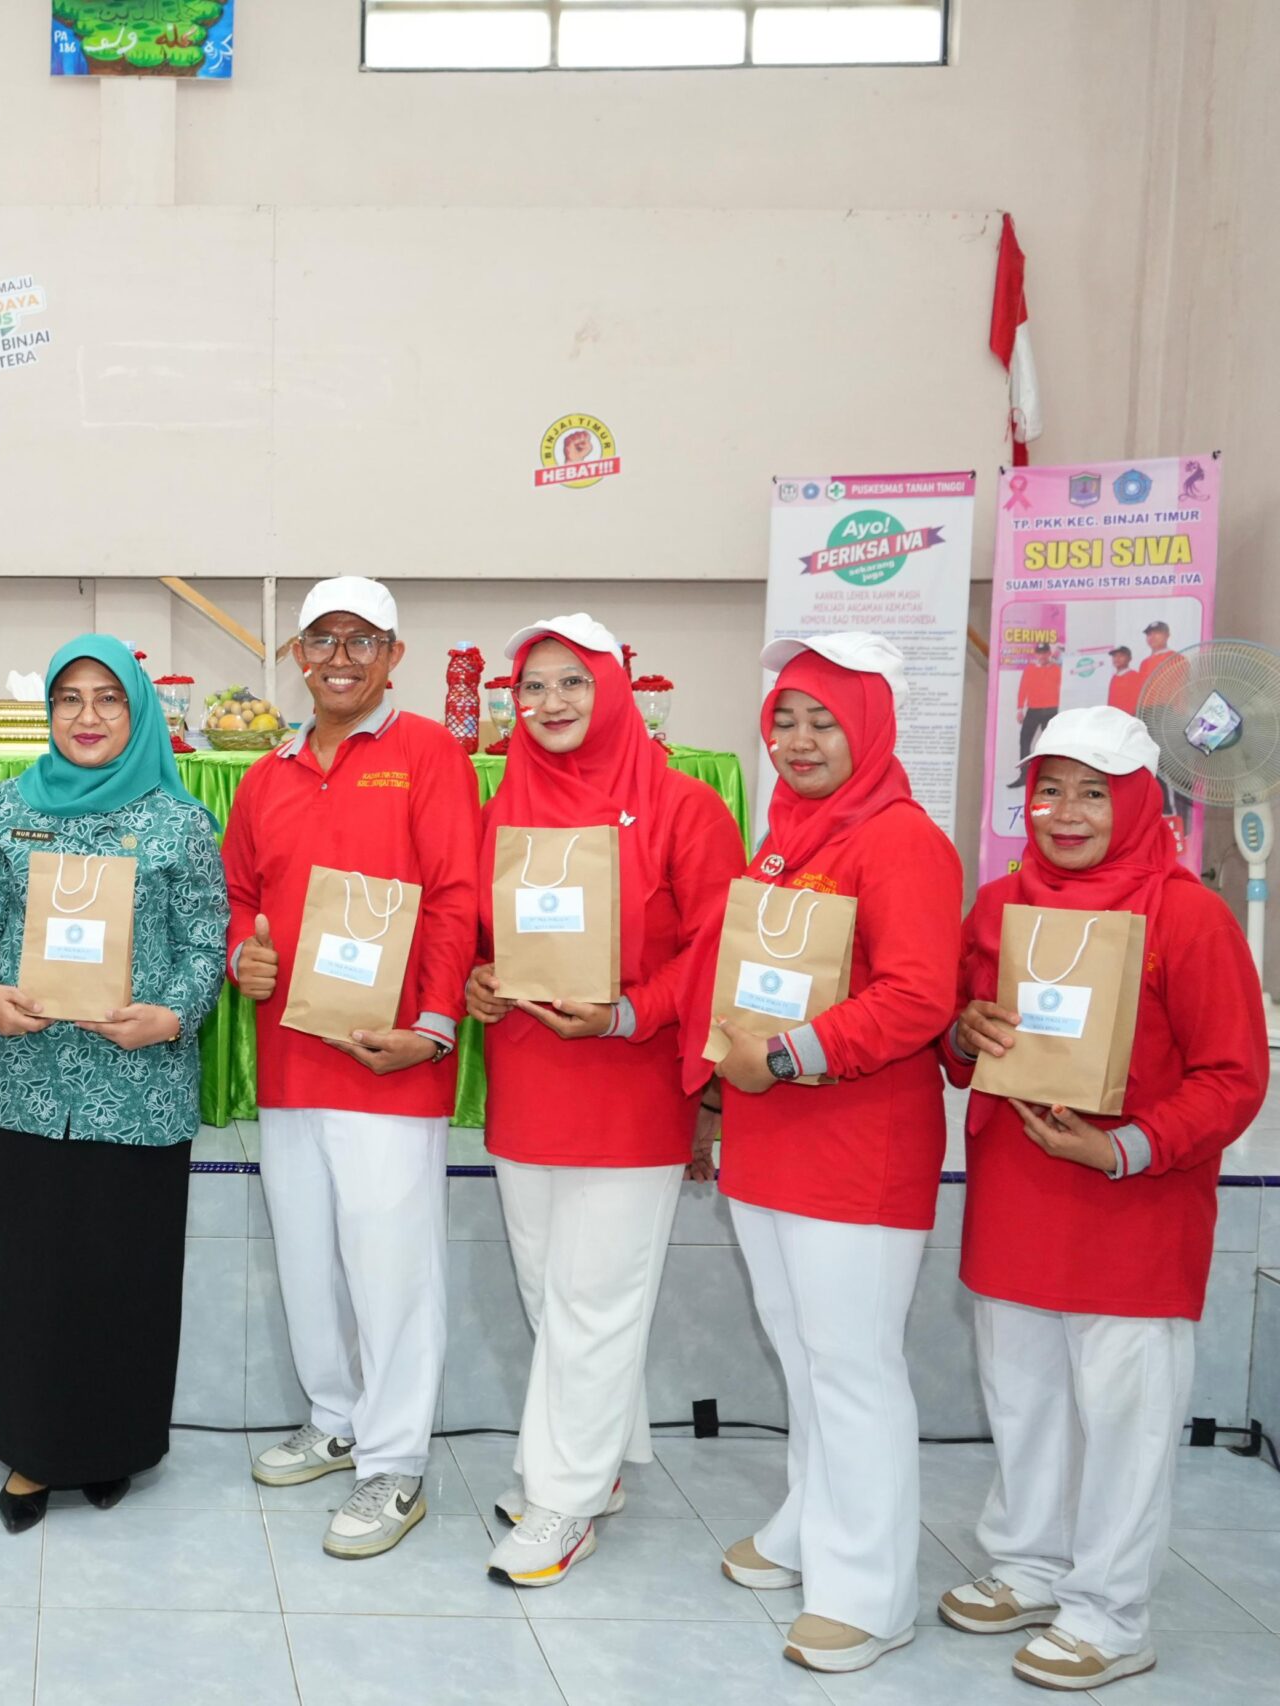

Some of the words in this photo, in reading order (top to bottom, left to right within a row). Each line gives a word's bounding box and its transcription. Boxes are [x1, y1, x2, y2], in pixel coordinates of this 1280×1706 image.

[54, 30, 68, 43] PA
[1, 331, 50, 351] BINJAI
[545, 419, 572, 459] BINJAI
[579, 417, 611, 449] TIMUR
[542, 460, 614, 483] HEBAT!!!
[851, 483, 903, 494] PUSKESMAS
[907, 482, 935, 492] TANAH
[937, 481, 965, 492] TINGGI
[843, 517, 891, 539] Ayo!
[1014, 520, 1030, 529] TP.
[1035, 518, 1062, 528] PKK
[1068, 516, 1098, 527] KEC.
[1104, 514, 1149, 525] BINJAI
[1154, 511, 1199, 522] TIMUR
[817, 538, 890, 570] PERIKSA
[896, 531, 923, 552] IVA
[1024, 539, 1103, 570] SUSI
[1111, 535, 1192, 566] SIVA
[849, 560, 895, 576] sekarang
[1006, 581, 1042, 591] SUAMI
[1047, 579, 1094, 589] SAYANG
[1099, 577, 1130, 587] ISTRI
[1135, 575, 1176, 586] SADAR
[1181, 574, 1201, 584] IVA
[1005, 628, 1057, 643] CERIWIS
